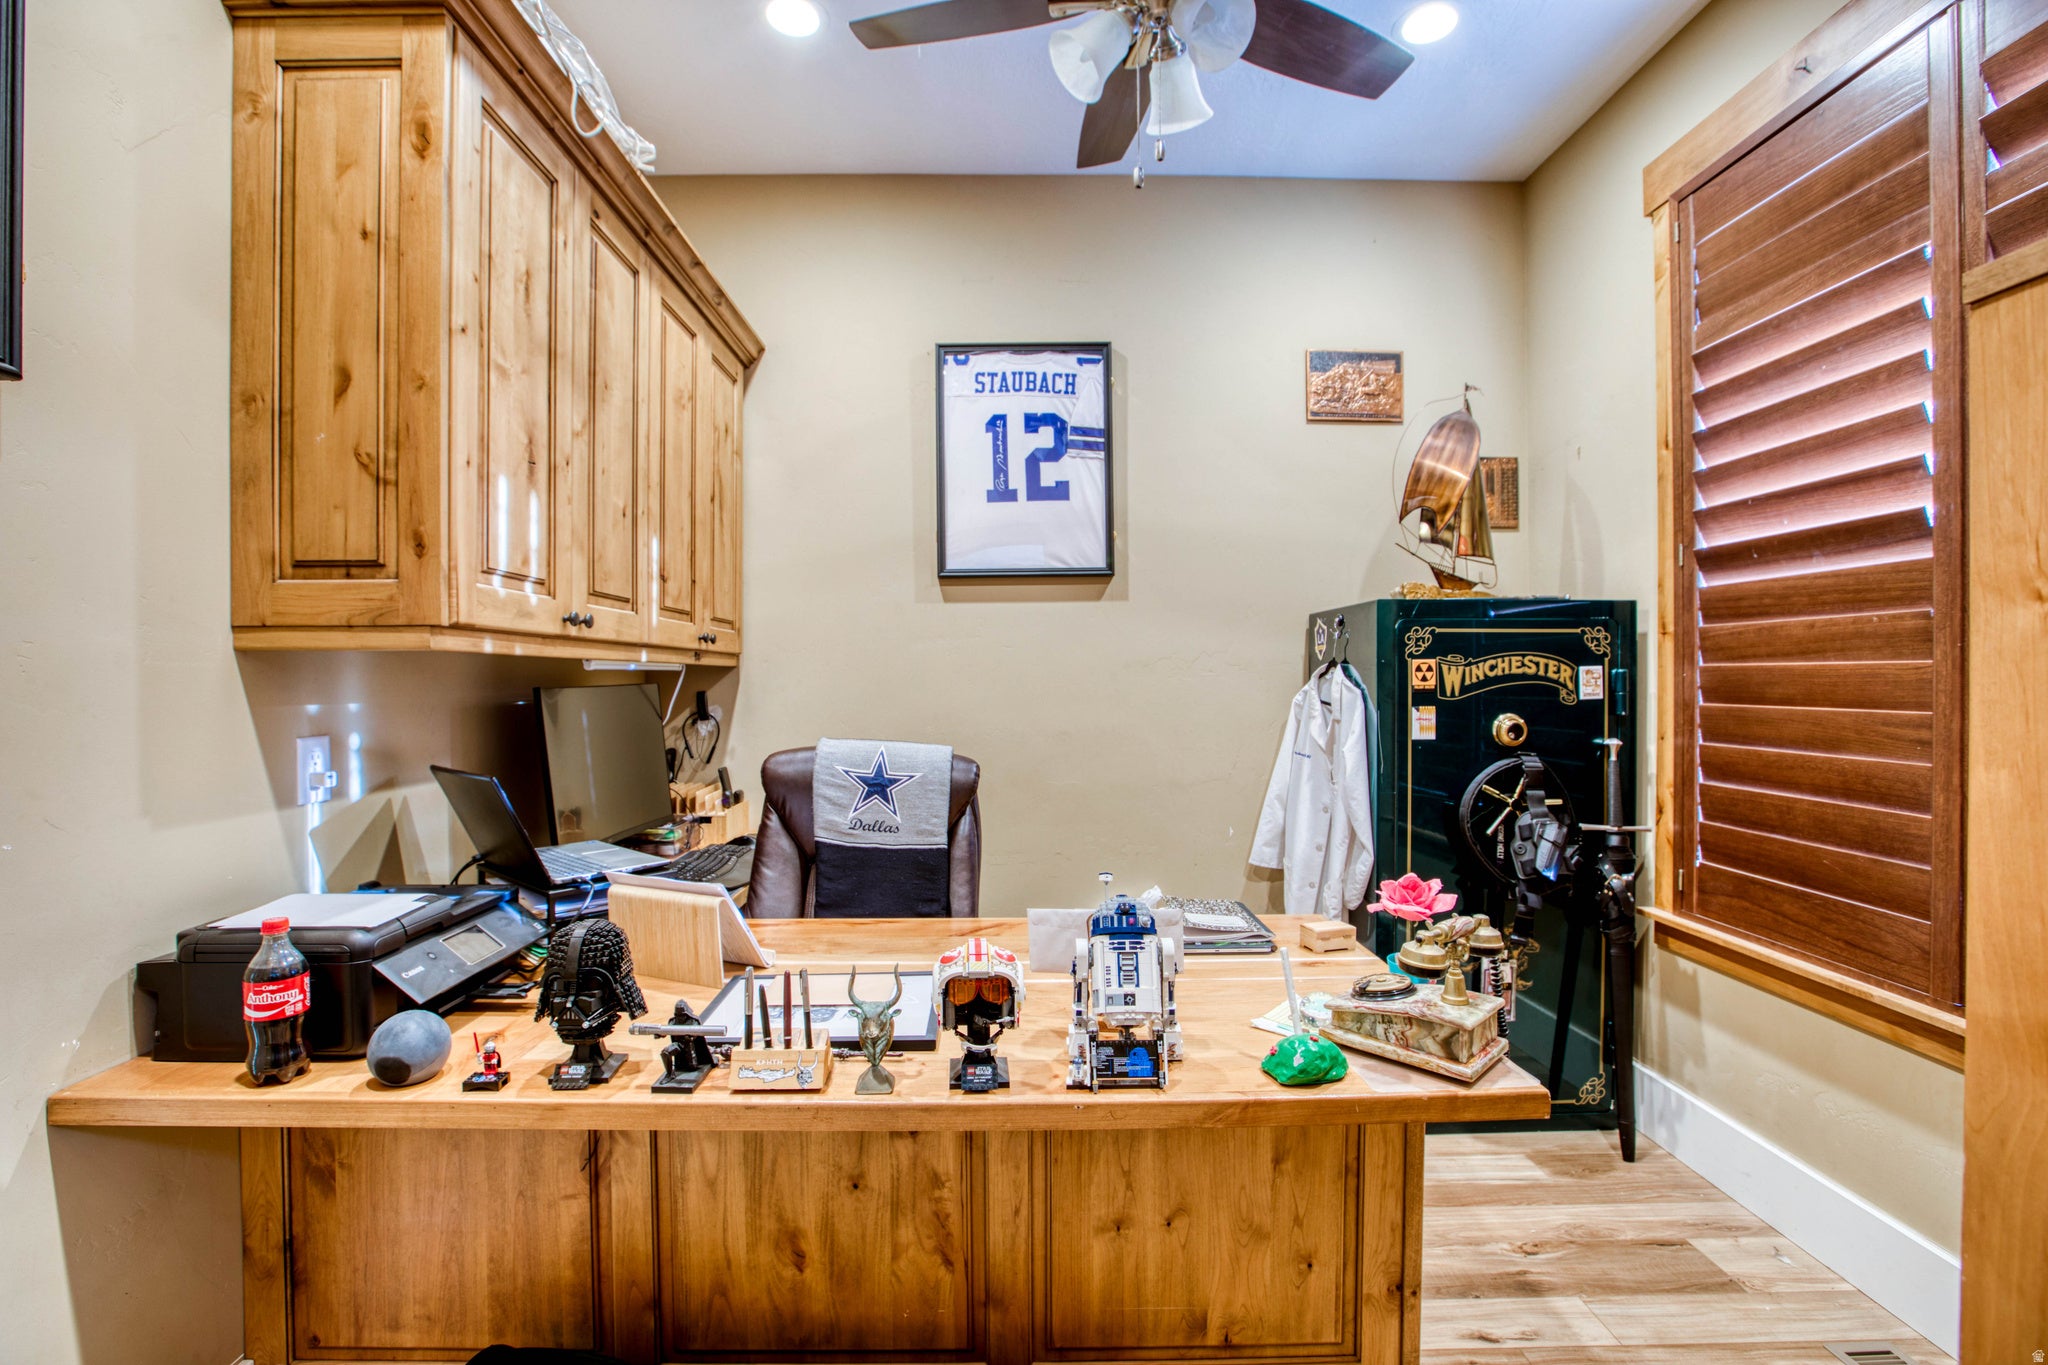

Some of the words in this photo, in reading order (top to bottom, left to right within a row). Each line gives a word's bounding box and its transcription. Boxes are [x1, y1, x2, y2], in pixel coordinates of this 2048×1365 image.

[974, 371, 1078, 395] STAUBACH
[985, 412, 1070, 503] 12
[1440, 655, 1574, 698] WINCHESTER
[848, 817, 900, 834] Dallas
[247, 988, 300, 1005] Anthony
